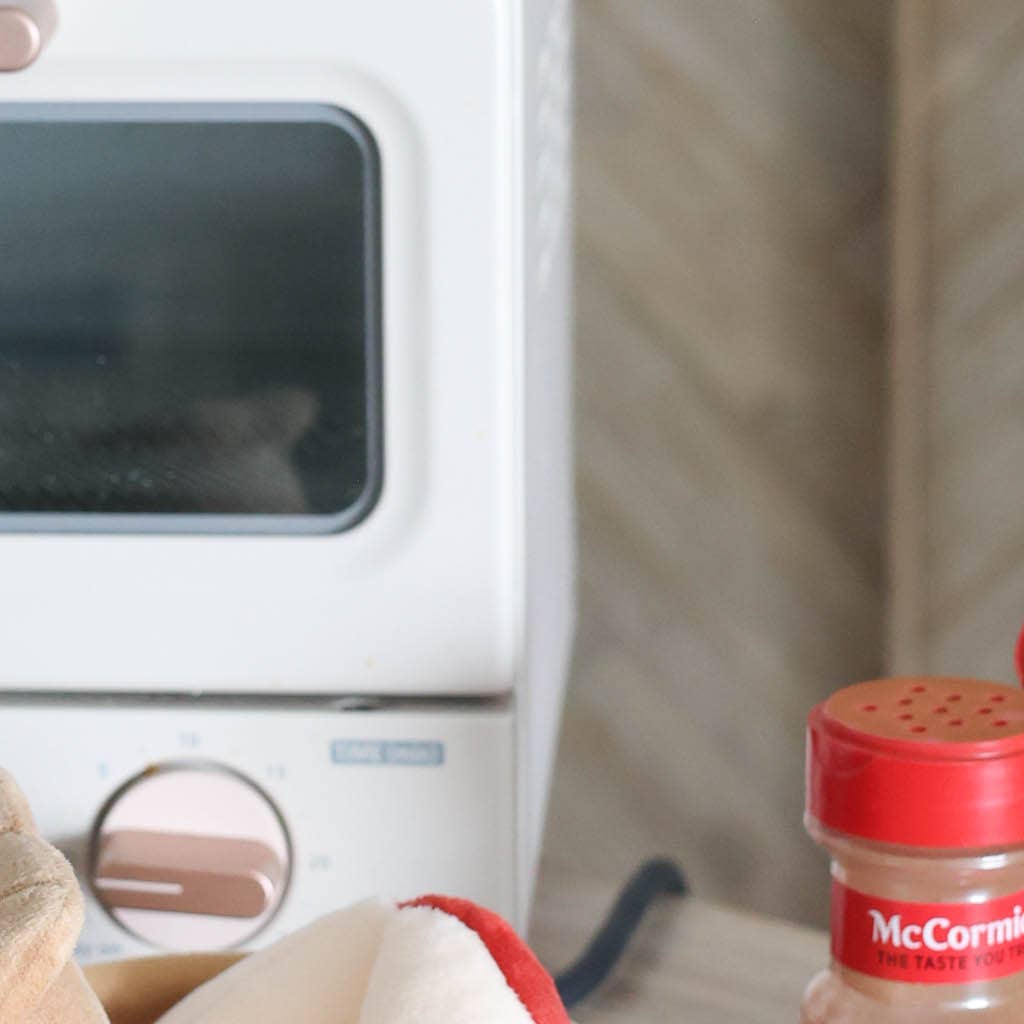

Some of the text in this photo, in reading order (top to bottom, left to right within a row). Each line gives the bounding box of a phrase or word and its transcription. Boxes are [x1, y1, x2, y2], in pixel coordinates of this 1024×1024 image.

[877, 951, 907, 969] THE
[916, 954, 968, 972] TASTE
[975, 948, 1005, 967] YOU
